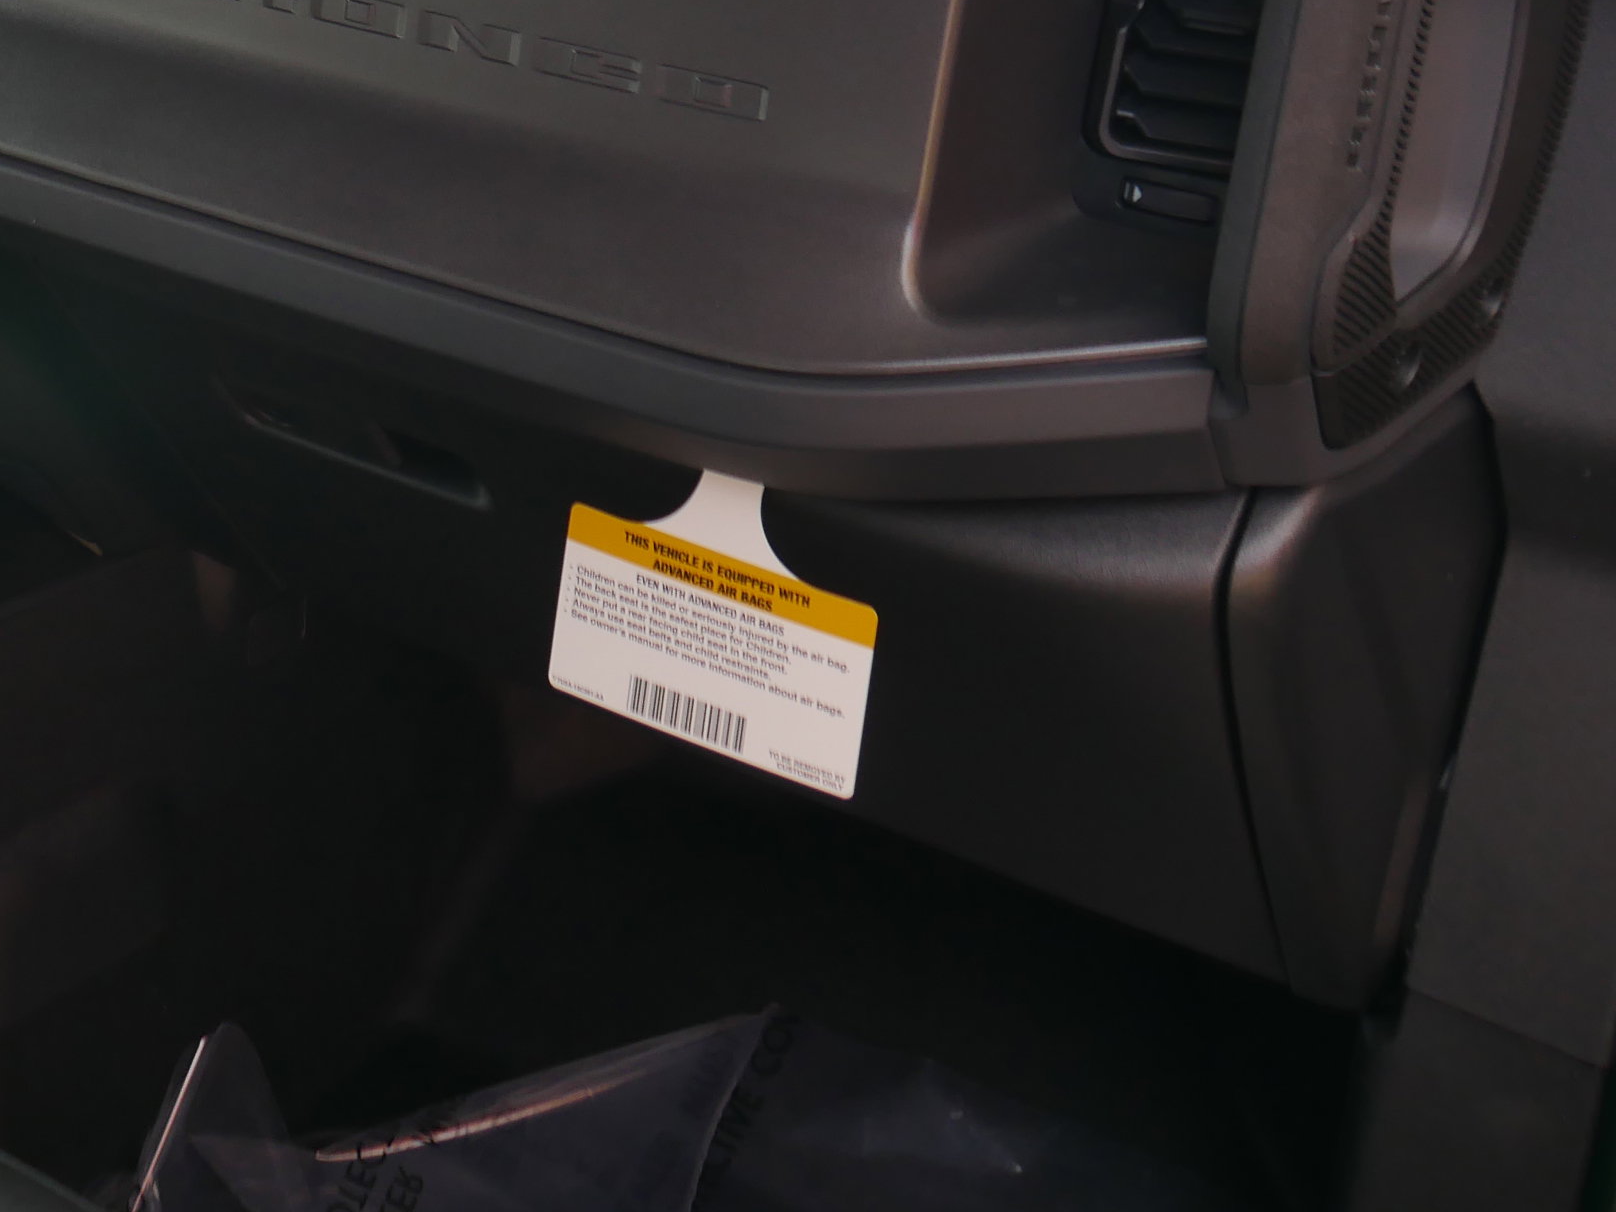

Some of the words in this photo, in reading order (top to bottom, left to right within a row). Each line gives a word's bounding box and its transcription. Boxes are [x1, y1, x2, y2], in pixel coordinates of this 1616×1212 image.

[624, 531, 651, 548] THIS
[652, 540, 700, 564] VEHICLE
[716, 566, 775, 594] EQUIPPED
[776, 586, 810, 610] WITH
[636, 573, 659, 590] EVEN
[661, 582, 685, 600] WITH
[688, 593, 736, 618] ADVANCED
[739, 612, 756, 626] AIR
[758, 618, 784, 635] BAGS
[652, 559, 718, 592] ADVANCED
[717, 582, 740, 600] AIR
[738, 591, 772, 612] BAGS
[572, 598, 604, 617] Always
[606, 611, 624, 625] use
[626, 620, 646, 634] seat
[648, 626, 671, 643] belts
[673, 635, 692, 651] and
[694, 645, 719, 661] child
[573, 586, 600, 603] Never
[601, 598, 618, 612] put
[627, 607, 647, 623] rear
[648, 615, 678, 636] facing
[679, 628, 704, 644] child
[706, 638, 727, 653] seat
[741, 649, 758, 664] the
[574, 575, 592, 591] The
[594, 582, 616, 600] back
[618, 594, 638, 608] seat
[651, 604, 666, 618] the
[668, 612, 698, 631] safest
[699, 623, 727, 641] place
[728, 632, 743, 646] for
[576, 564, 615, 588] Children
[617, 582, 634, 595] can
[650, 592, 679, 611] killed
[691, 609, 736, 633] seriously
[738, 625, 774, 646] injured
[791, 644, 808, 658] the
[810, 652, 824, 663] air
[570, 608, 588, 622] See
[589, 616, 626, 637] owner's
[628, 632, 663, 651] manual
[664, 642, 679, 657] for
[680, 651, 706, 668] more
[708, 660, 765, 689] information
[768, 684, 797, 702] about
[799, 696, 814, 707] air
